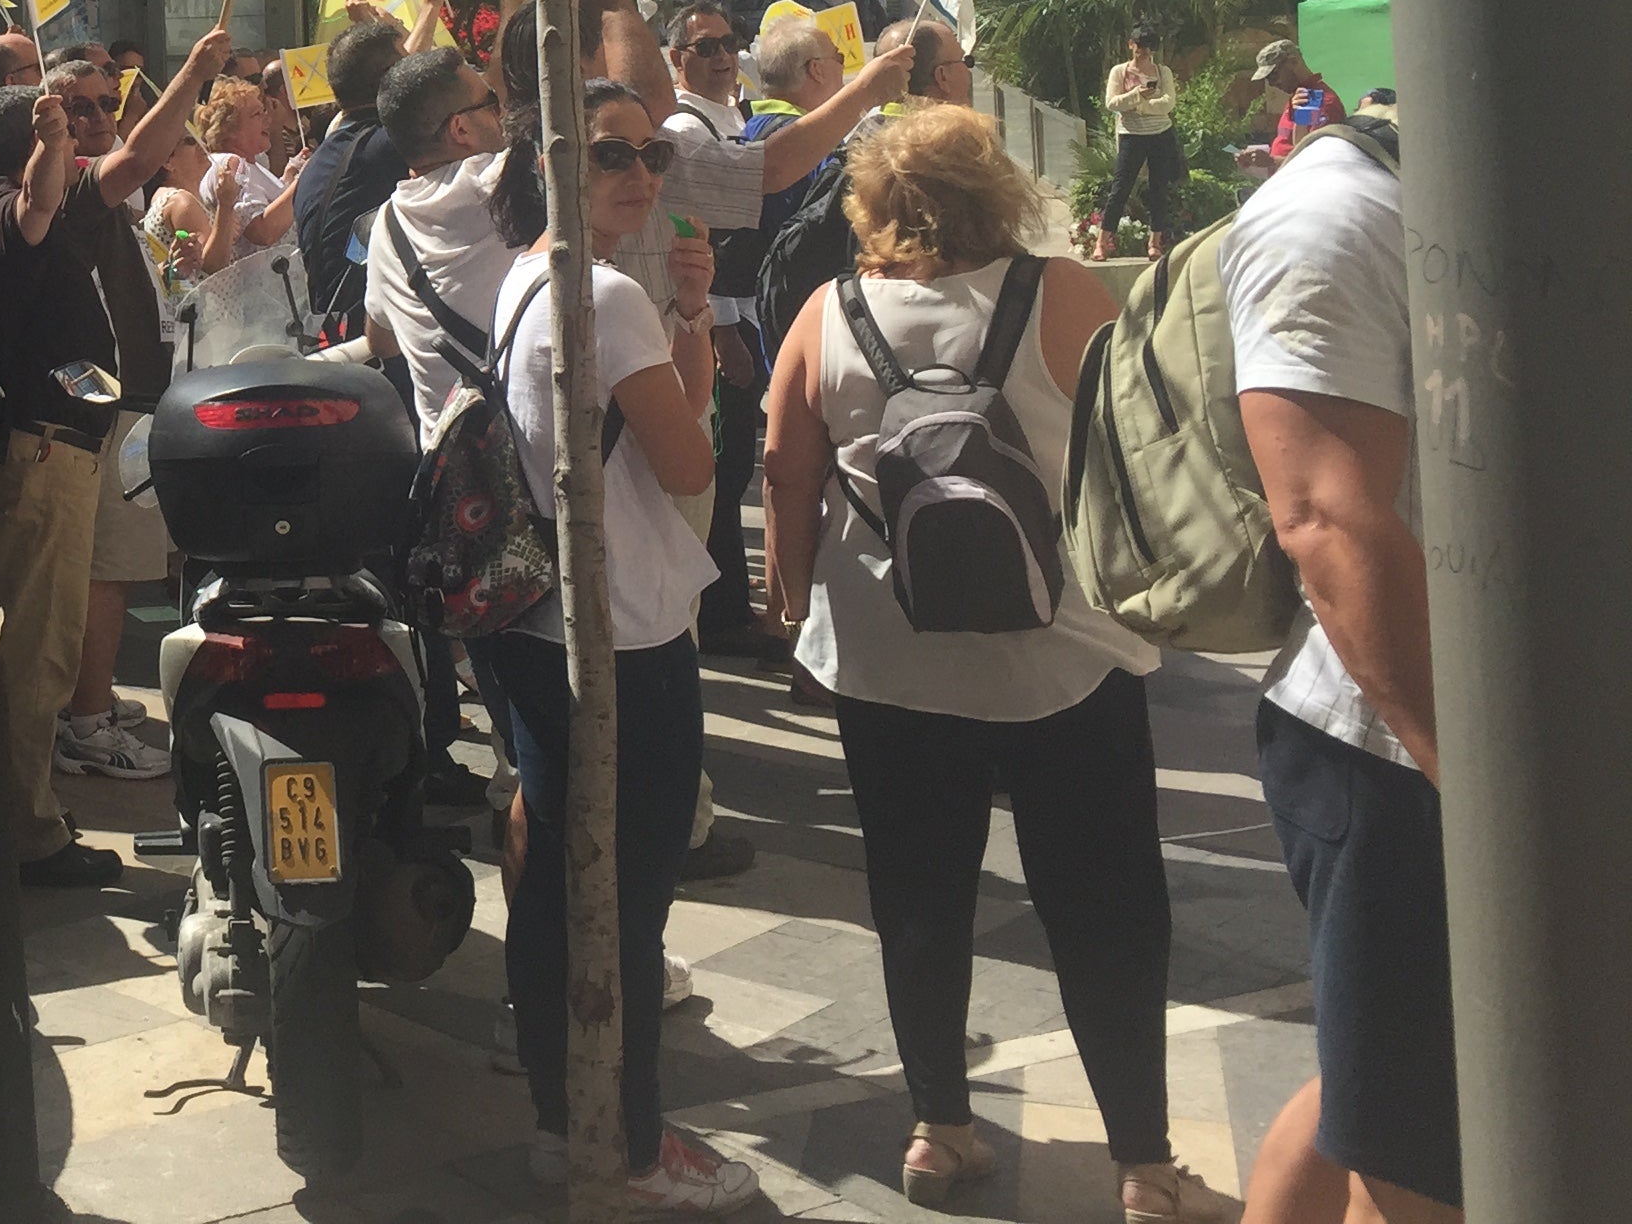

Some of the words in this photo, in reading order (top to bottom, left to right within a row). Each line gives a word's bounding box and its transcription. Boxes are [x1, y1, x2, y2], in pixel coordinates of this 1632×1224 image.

[235, 405, 321, 421] SHAD
[287, 776, 315, 802] C9
[281, 837, 326, 862] BVG
